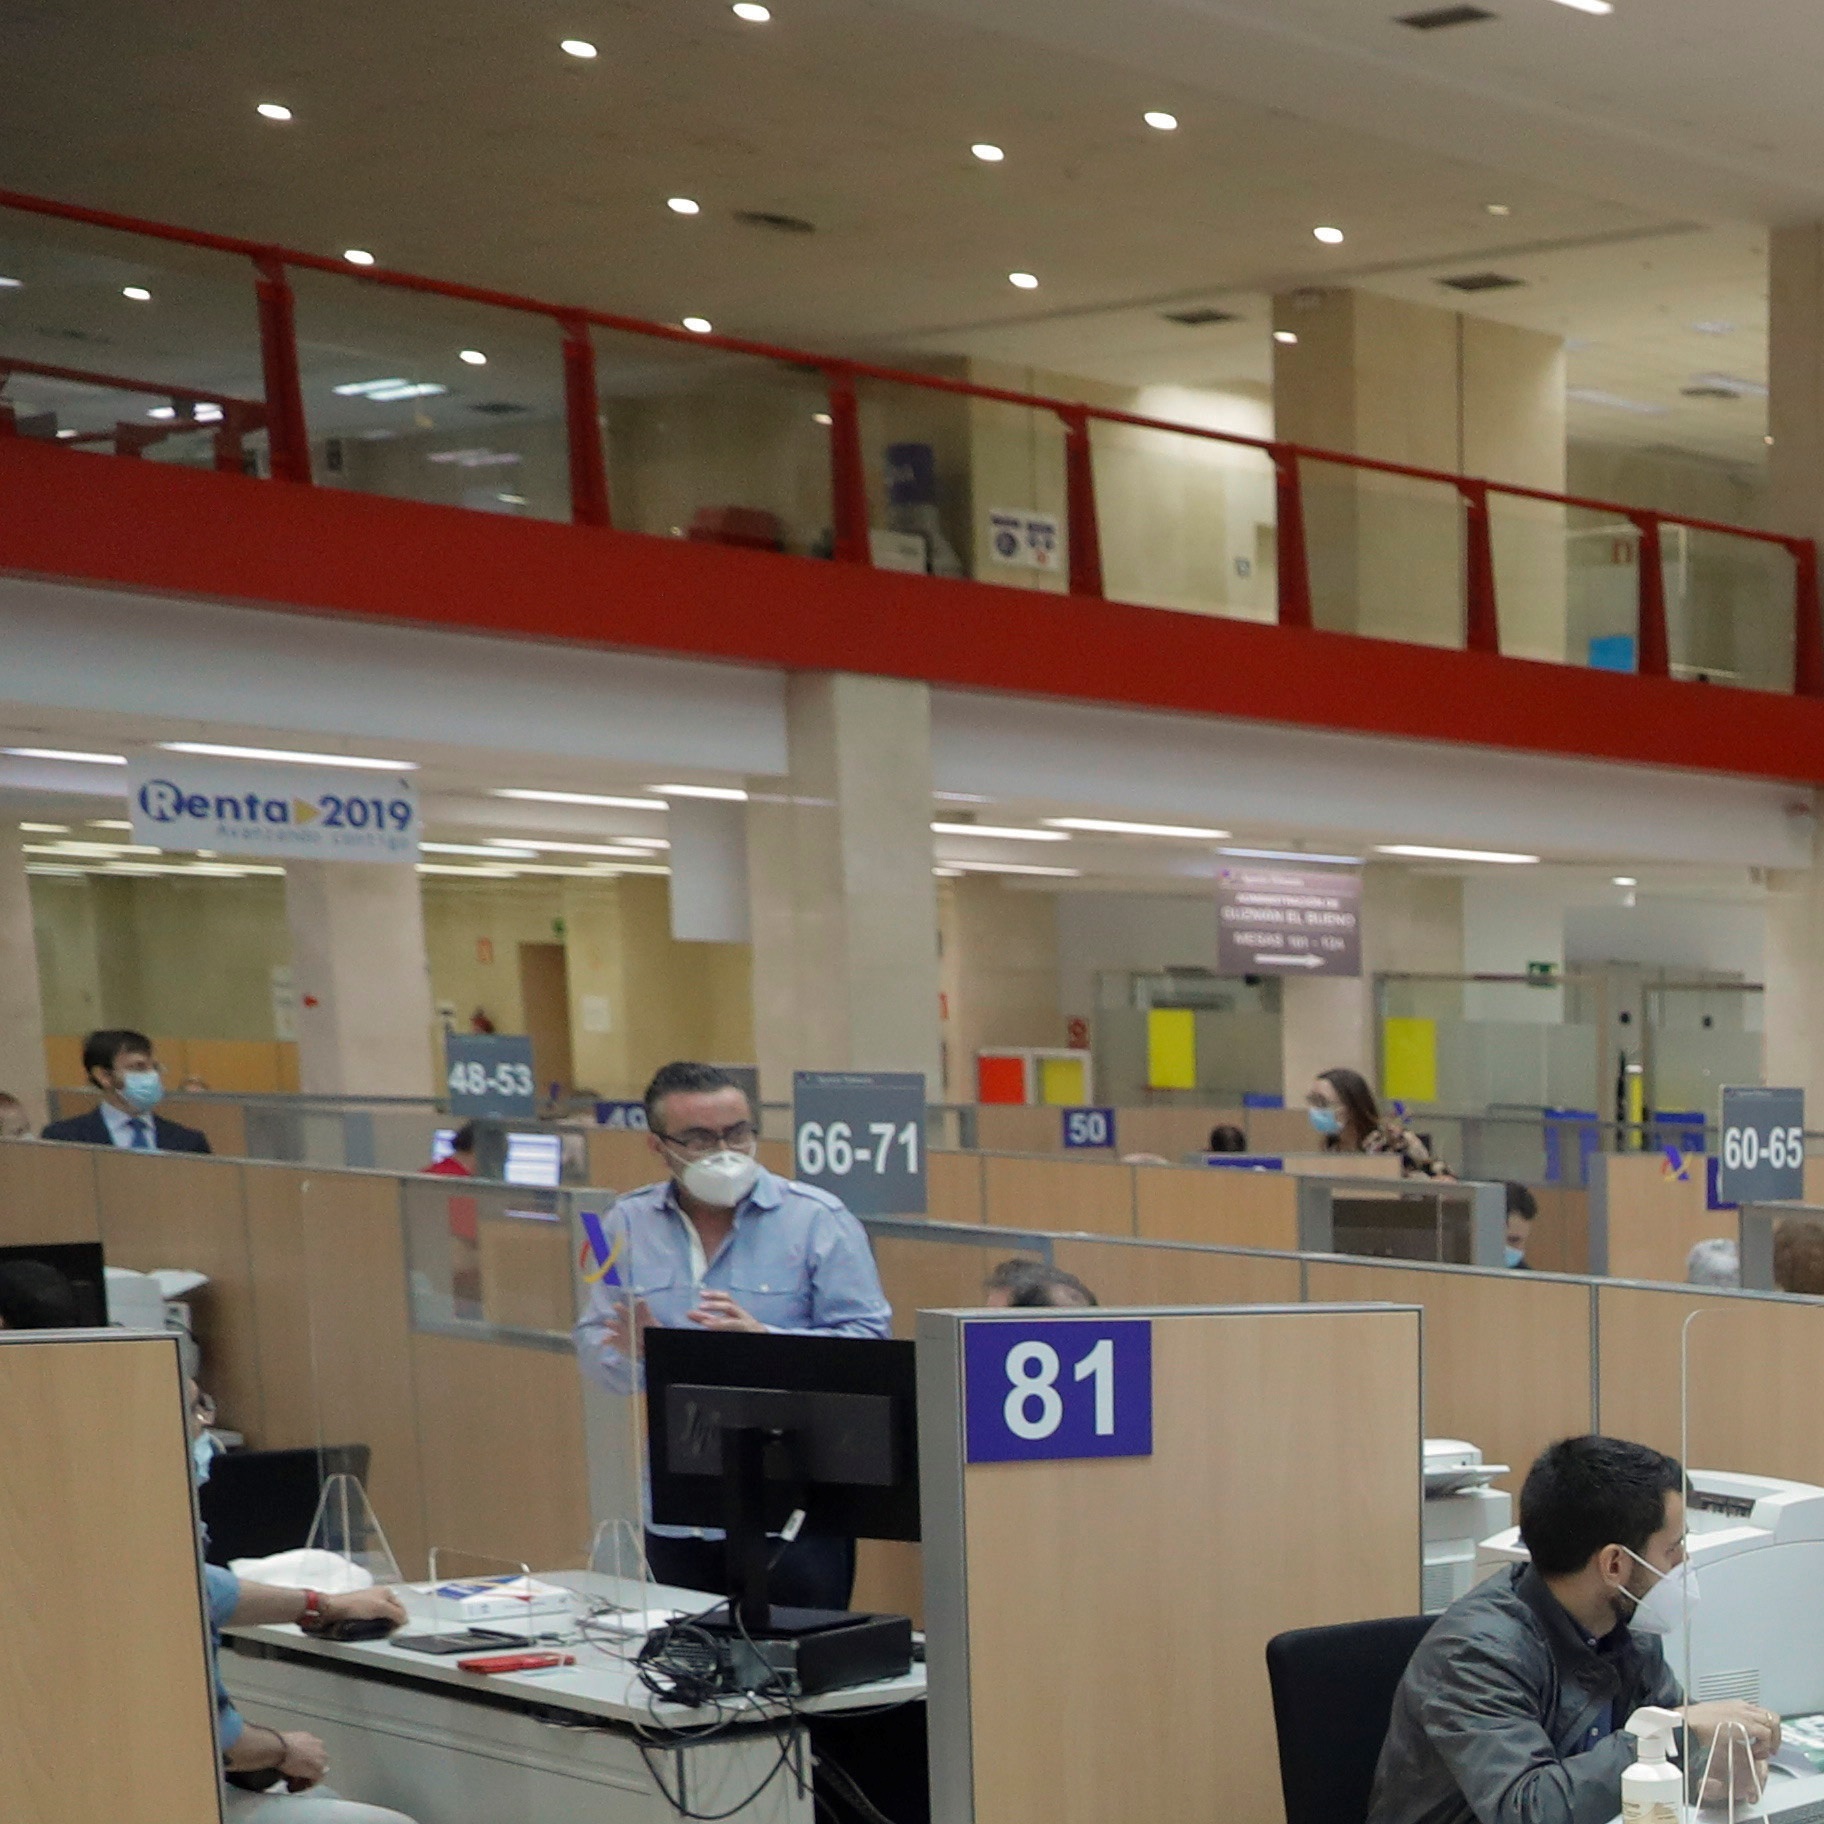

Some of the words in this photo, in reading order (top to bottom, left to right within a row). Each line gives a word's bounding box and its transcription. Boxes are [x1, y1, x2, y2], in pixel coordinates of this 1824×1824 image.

[139, 778, 289, 823] Renta
[320, 793, 413, 832] 2019
[1304, 911, 1357, 928] BUENO
[448, 1061, 533, 1098] 48-53
[797, 1121, 920, 1177] 66-71
[1068, 1112, 1107, 1144] 50
[1724, 1126, 1803, 1170] 60-65
[1004, 1339, 1115, 1440] 81
